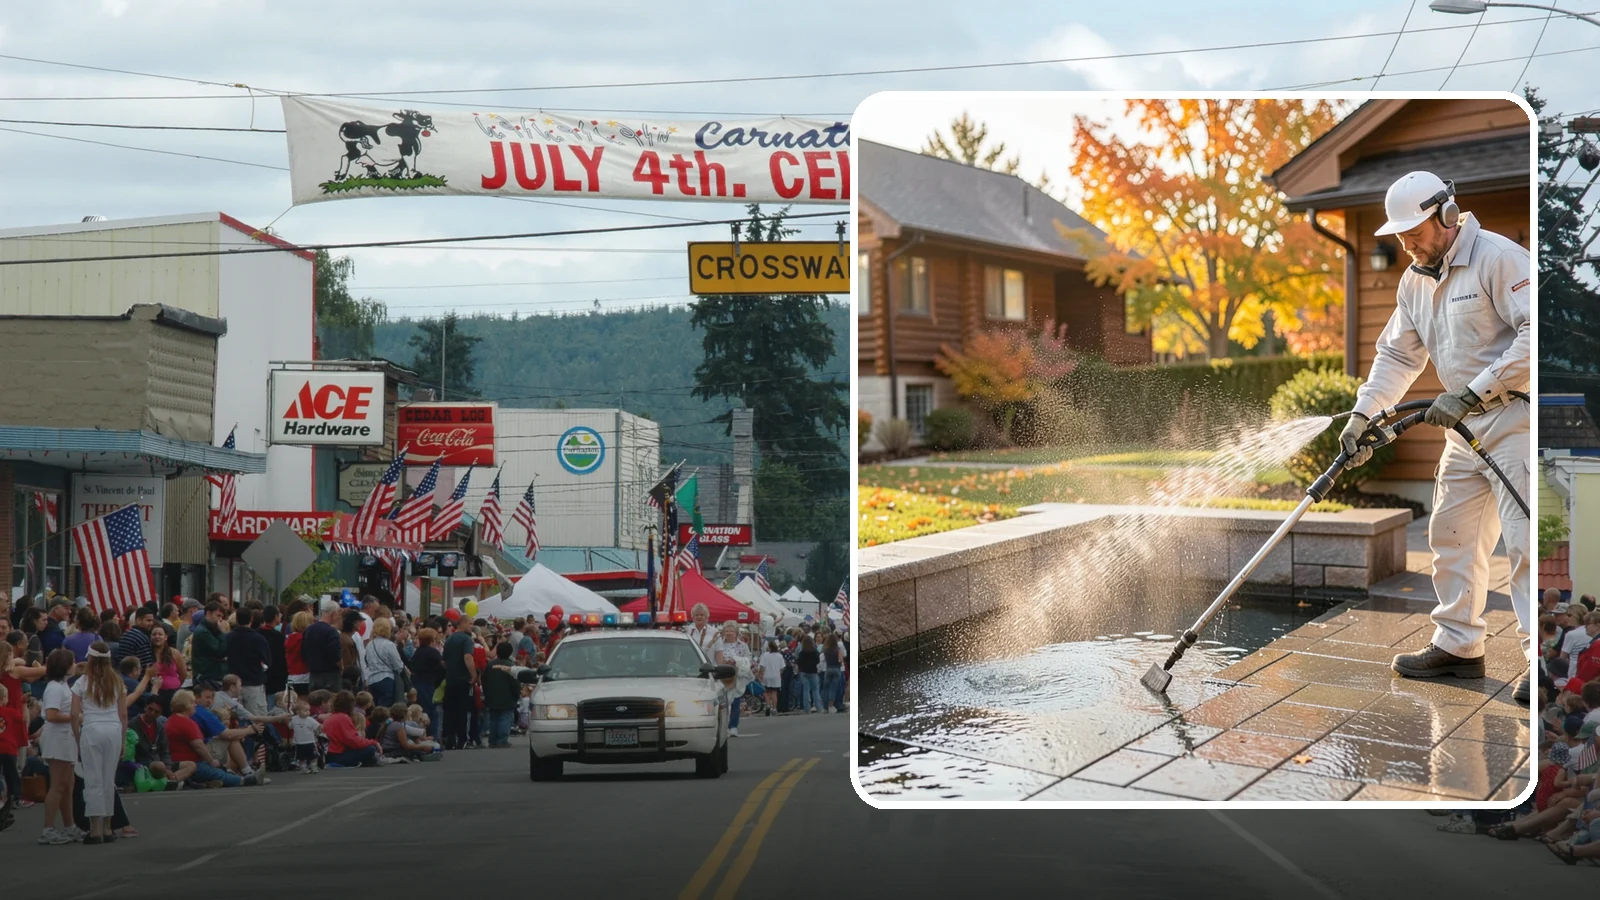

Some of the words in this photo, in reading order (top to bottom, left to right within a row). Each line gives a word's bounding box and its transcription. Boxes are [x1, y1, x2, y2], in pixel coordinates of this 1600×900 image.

[694, 121, 850, 150] Carnat
[481, 141, 605, 192] JULY
[632, 150, 747, 198] 4th.
[696, 254, 850, 280] CROSSWA
[282, 380, 374, 420] ACE
[405, 409, 452, 422] CEDAR
[461, 409, 485, 422] LOG
[283, 421, 371, 436] Hardware
[416, 428, 477, 447] Coca-Cola
[353, 467, 384, 480] Simpl
[83, 485, 94, 494] St.
[95, 485, 124, 494] Vincent
[126, 486, 136, 495] de
[137, 486, 155, 495] Paul
[688, 526, 741, 535] CRNATION
[699, 535, 730, 543] GLASS
